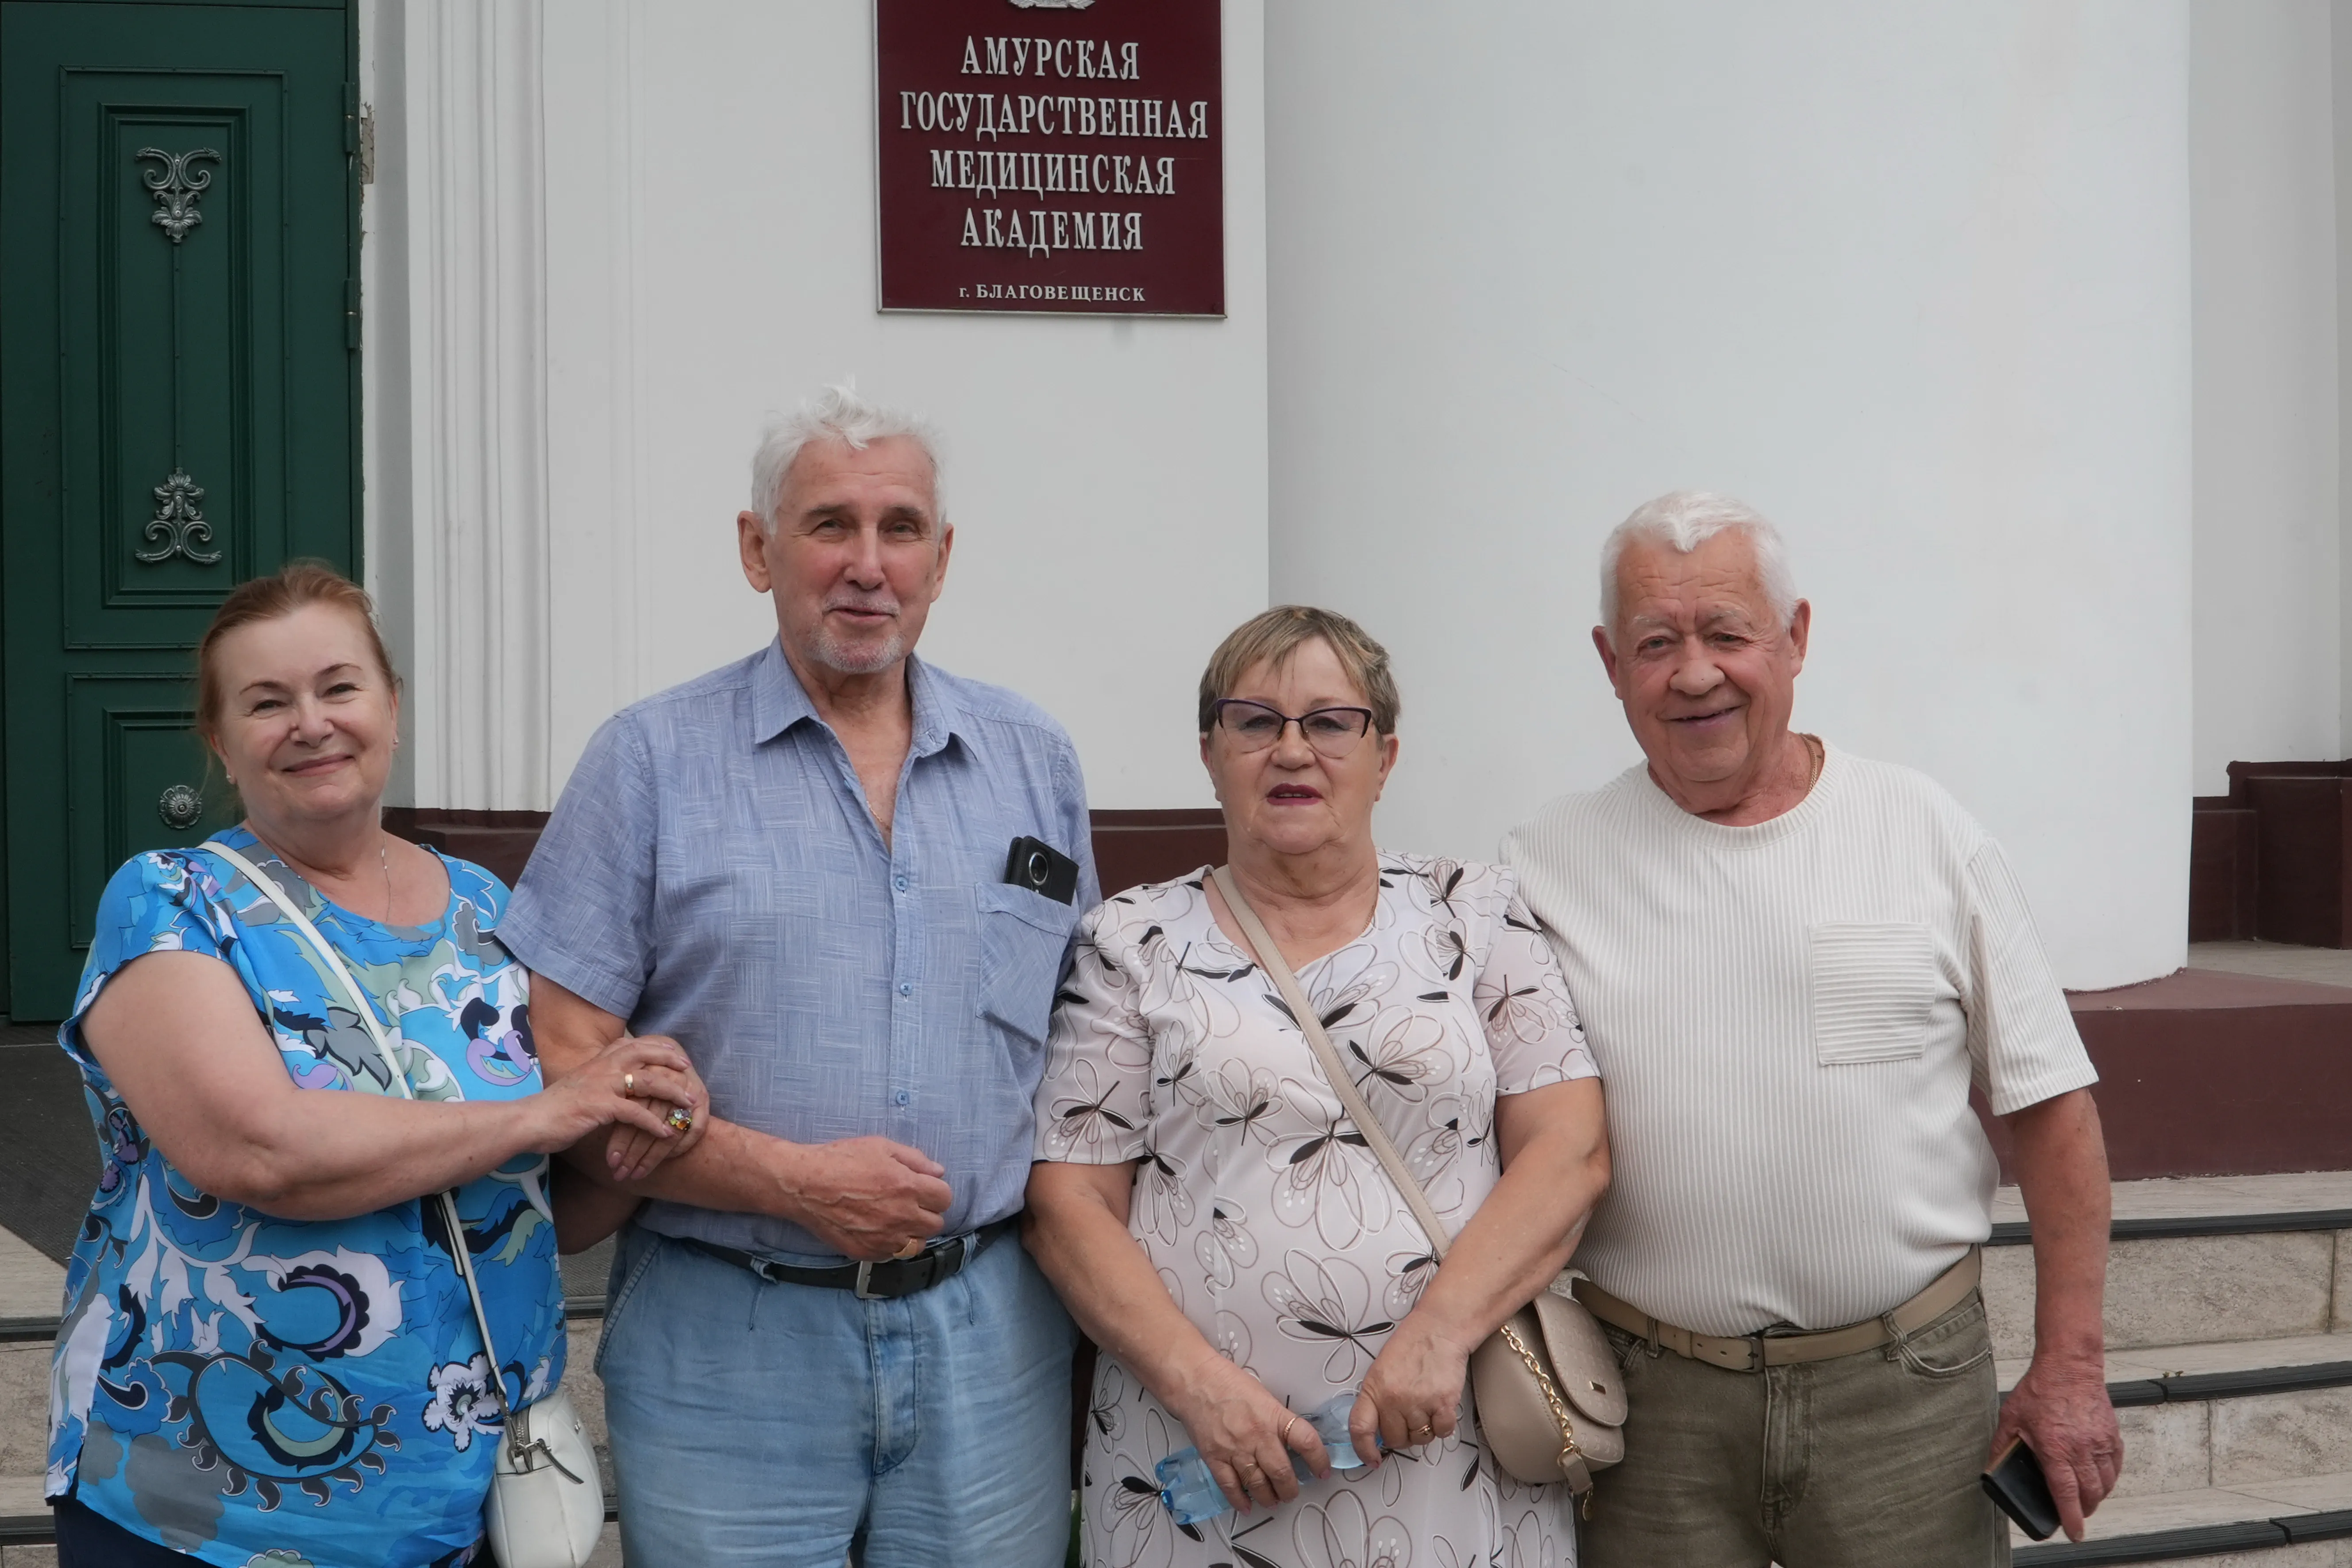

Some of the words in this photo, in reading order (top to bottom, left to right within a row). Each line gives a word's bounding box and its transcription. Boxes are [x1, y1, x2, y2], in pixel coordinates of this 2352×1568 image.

[961, 36, 1140, 81] АМУРСКАЯ
[900, 91, 1209, 143] ГОСУДАРСТВЕННАЯ
[930, 150, 1176, 201] МЕДИЦИНСКАЯ
[961, 208, 1144, 259] АКАДЕМИЯ
[959, 288, 970, 298] г.
[976, 284, 1146, 303] БЛАГОВЕЩЕНСК
